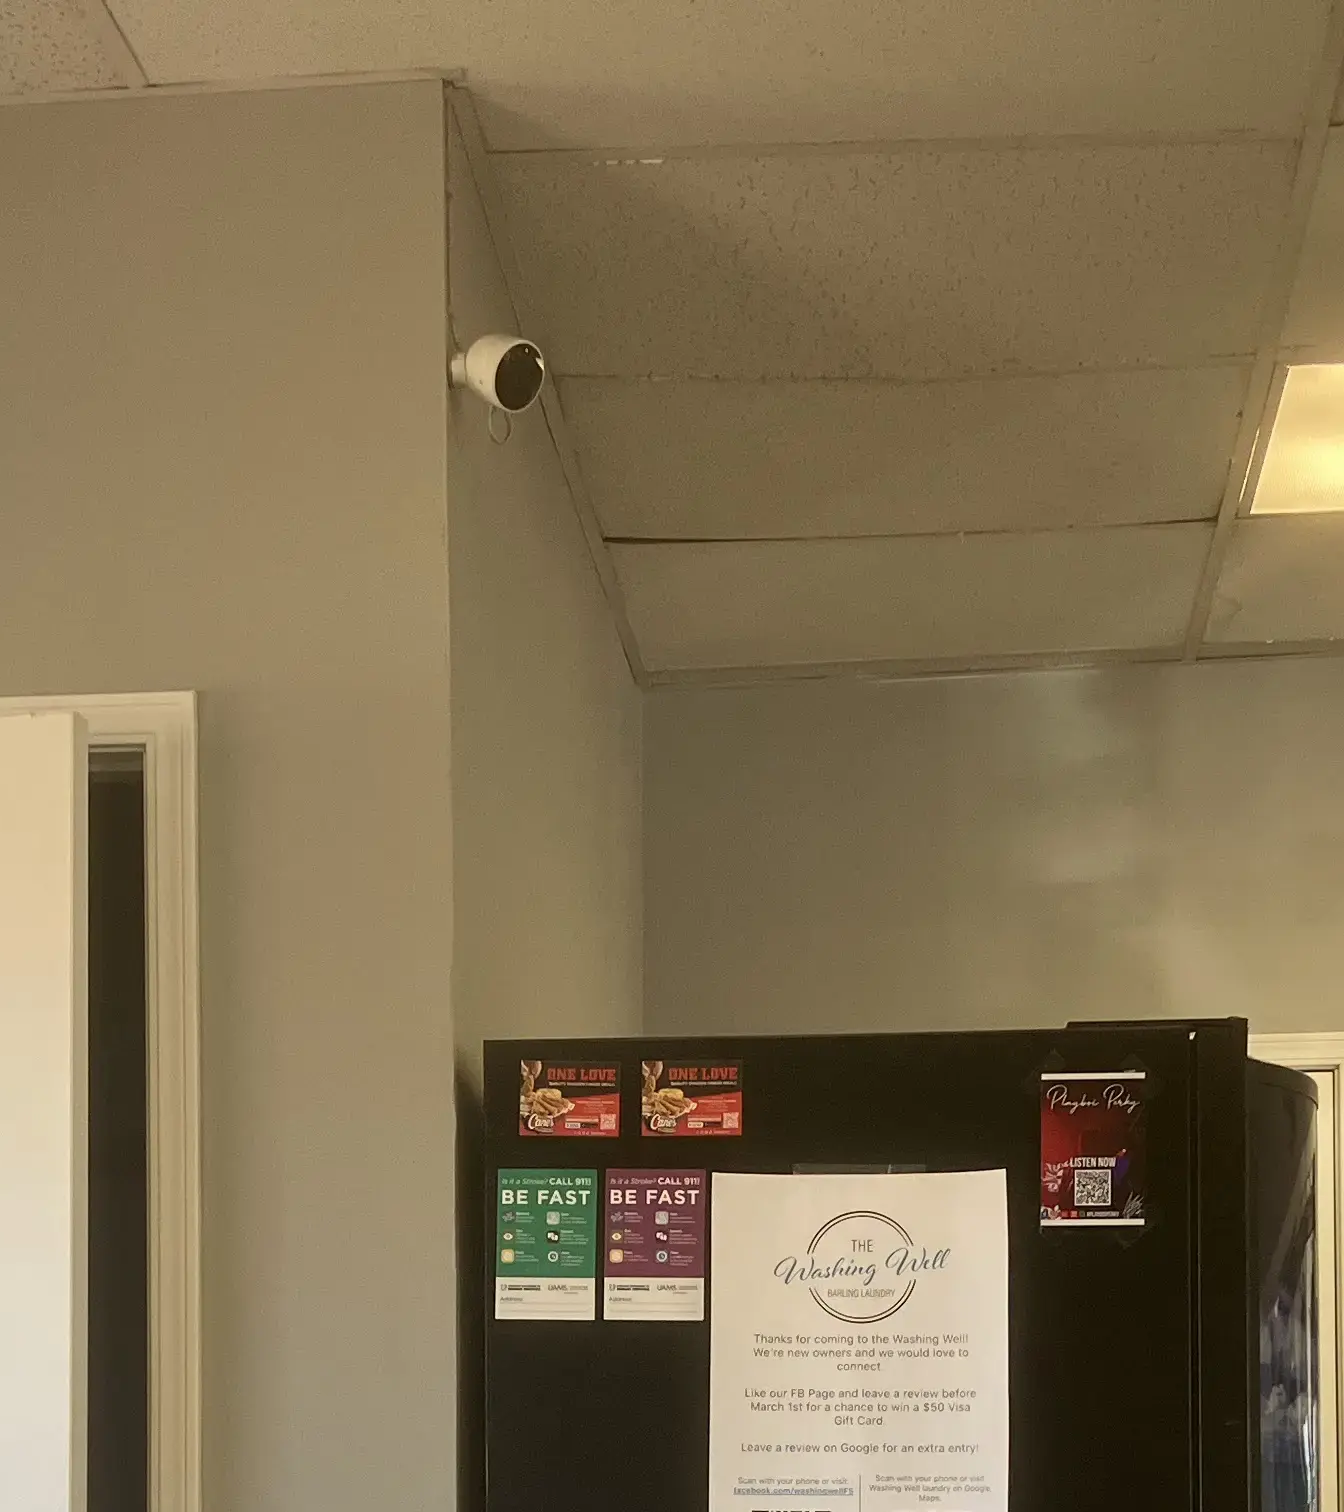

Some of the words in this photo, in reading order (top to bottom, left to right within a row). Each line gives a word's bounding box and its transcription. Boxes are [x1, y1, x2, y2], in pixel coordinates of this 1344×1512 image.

[547, 1068, 576, 1081] ONE
[580, 1068, 616, 1081] LOVE
[668, 1068, 698, 1080] ONE
[701, 1067, 738, 1080] LOVE
[1069, 1157, 1097, 1168] LISTEN
[1098, 1157, 1117, 1168] NOW
[548, 1177, 573, 1186] CALL
[657, 1177, 682, 1185] CALL
[501, 1189, 529, 1205] BE
[537, 1189, 591, 1205] FAST
[610, 1189, 637, 1205] BE
[646, 1189, 700, 1205] FAST
[851, 1239, 873, 1252] THE
[773, 1255, 880, 1286] Washing
[884, 1247, 951, 1276] Well
[827, 1288, 859, 1298] BARLING
[860, 1288, 895, 1298] LAUNDRY
[753, 1334, 793, 1344] Thanks
[795, 1334, 811, 1344] for
[813, 1335, 854, 1348] coming
[857, 1335, 868, 1345] to
[871, 1334, 889, 1344] the
[892, 1334, 939, 1347] Washing
[942, 1334, 969, 1344] Well!
[753, 1348, 784, 1358] We're
[787, 1350, 809, 1358] new
[812, 1350, 851, 1358] owners
[854, 1348, 875, 1358] and
[878, 1350, 894, 1358] we
[896, 1348, 930, 1358] would
[932, 1348, 955, 1358] love
[958, 1348, 969, 1358] to
[744, 1388, 766, 1399] Like
[769, 1390, 788, 1399] our
[790, 1388, 805, 1399] FB
[807, 1388, 836, 1401] Page
[838, 1388, 859, 1399] and
[861, 1388, 890, 1399] leave
[893, 1390, 900, 1399] a
[903, 1389, 939, 1399] review
[941, 1388, 977, 1399] before
[750, 1402, 784, 1412] March
[787, 1402, 803, 1412] 1st
[805, 1402, 822, 1412] for
[824, 1404, 831, 1412] a
[834, 1402, 874, 1412] chance
[876, 1403, 888, 1412] to
[891, 1402, 910, 1412] win
[912, 1404, 920, 1412] a
[923, 1402, 945, 1413] $50
[948, 1402, 971, 1412] Visa
[834, 1416, 854, 1426] Gift
[740, 1443, 773, 1453] Leave
[775, 1444, 782, 1453] a
[784, 1443, 821, 1453] review
[823, 1444, 837, 1453] on
[840, 1443, 880, 1455] Google
[882, 1443, 898, 1453] for
[901, 1444, 915, 1453] an
[917, 1444, 945, 1453] extra
[948, 1443, 979, 1455] entry!
